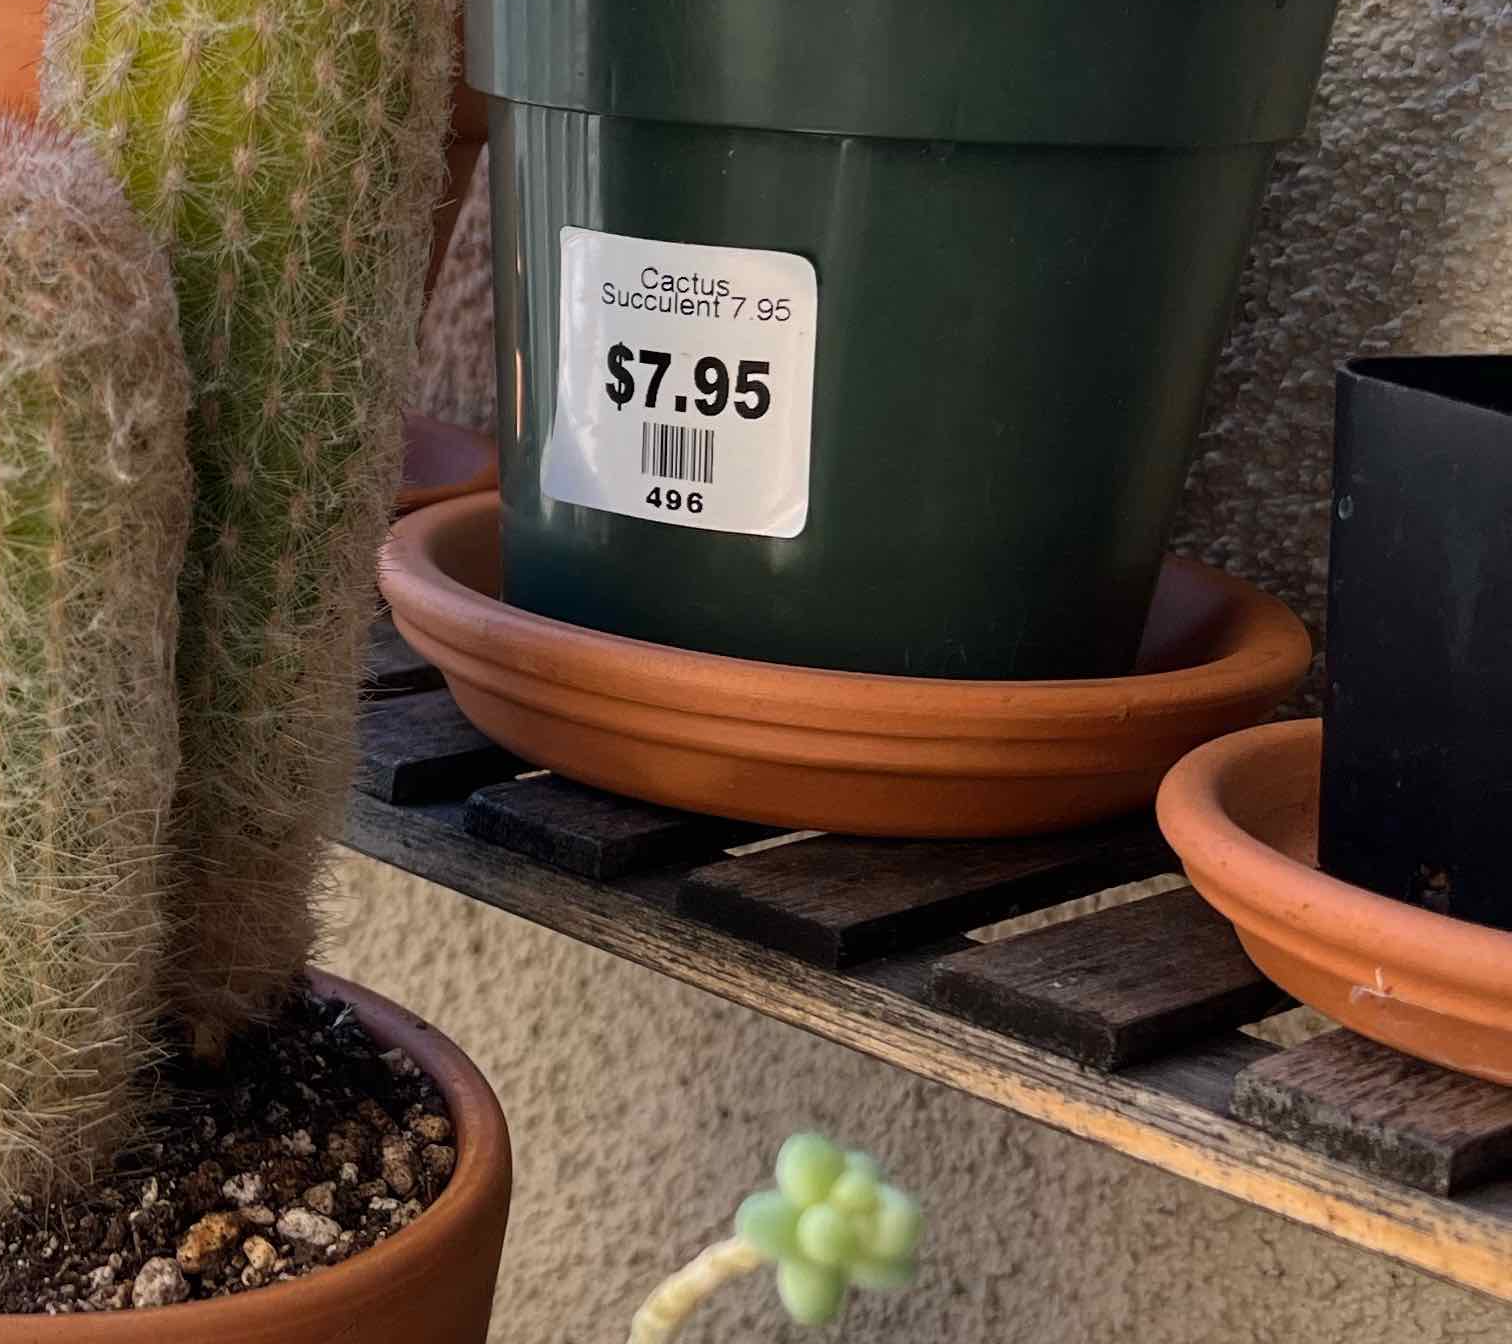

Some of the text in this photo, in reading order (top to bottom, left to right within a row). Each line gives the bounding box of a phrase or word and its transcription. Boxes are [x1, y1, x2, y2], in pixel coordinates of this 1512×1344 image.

[640, 267, 730, 297] Cactus
[601, 282, 791, 322] Succulent 7.95
[605, 341, 771, 420] $7.95
[645, 486, 704, 514] 496
